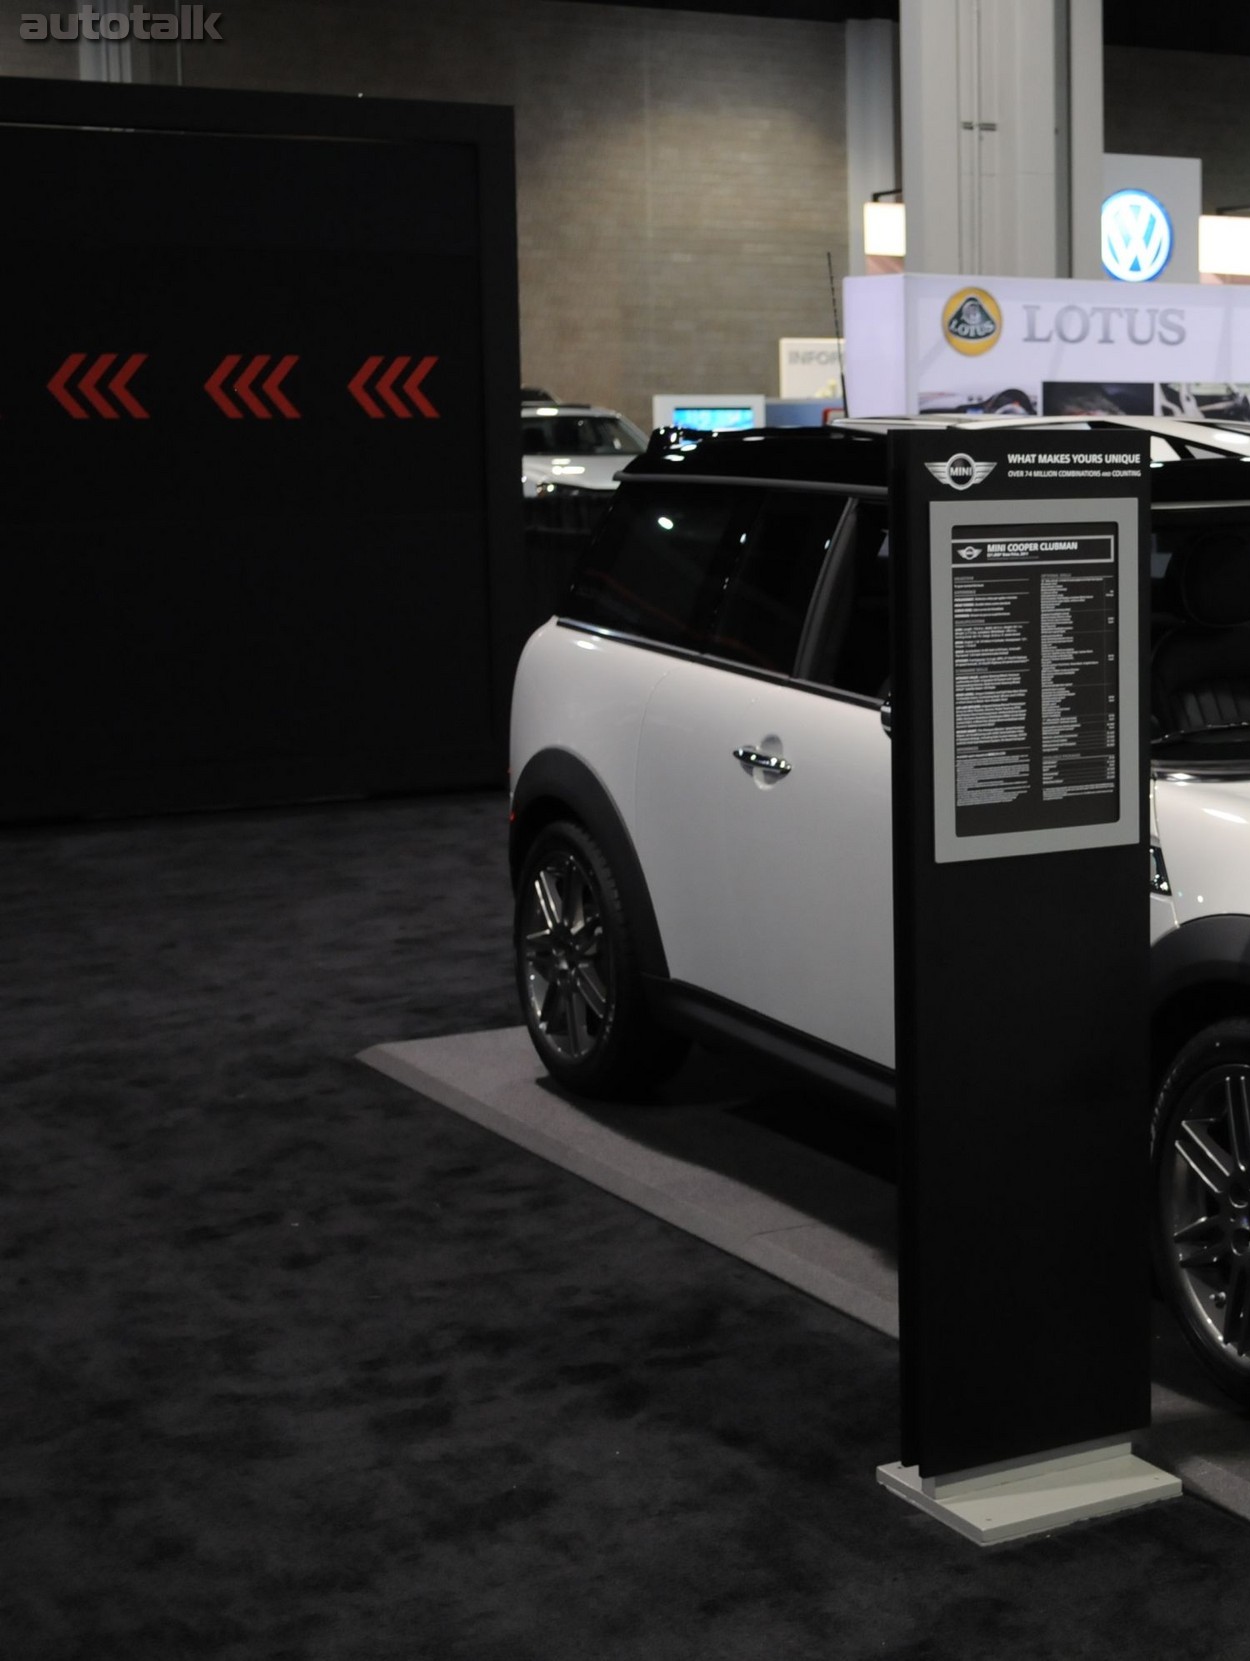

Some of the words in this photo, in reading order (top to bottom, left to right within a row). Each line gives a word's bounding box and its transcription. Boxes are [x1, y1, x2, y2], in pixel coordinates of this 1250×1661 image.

[949, 319, 995, 337] LOTUS
[1021, 304, 1187, 346] LOTUS
[1007, 453, 1037, 464] WHAT
[1038, 453, 1071, 464] MAKES
[1072, 453, 1103, 464] YOURS
[1104, 453, 1141, 465] UNIQUE
[950, 466, 973, 476] MINI
[987, 543, 1006, 552] MINI
[1007, 542, 1039, 552] COOPER
[1040, 541, 1078, 551] CLUBMAN
